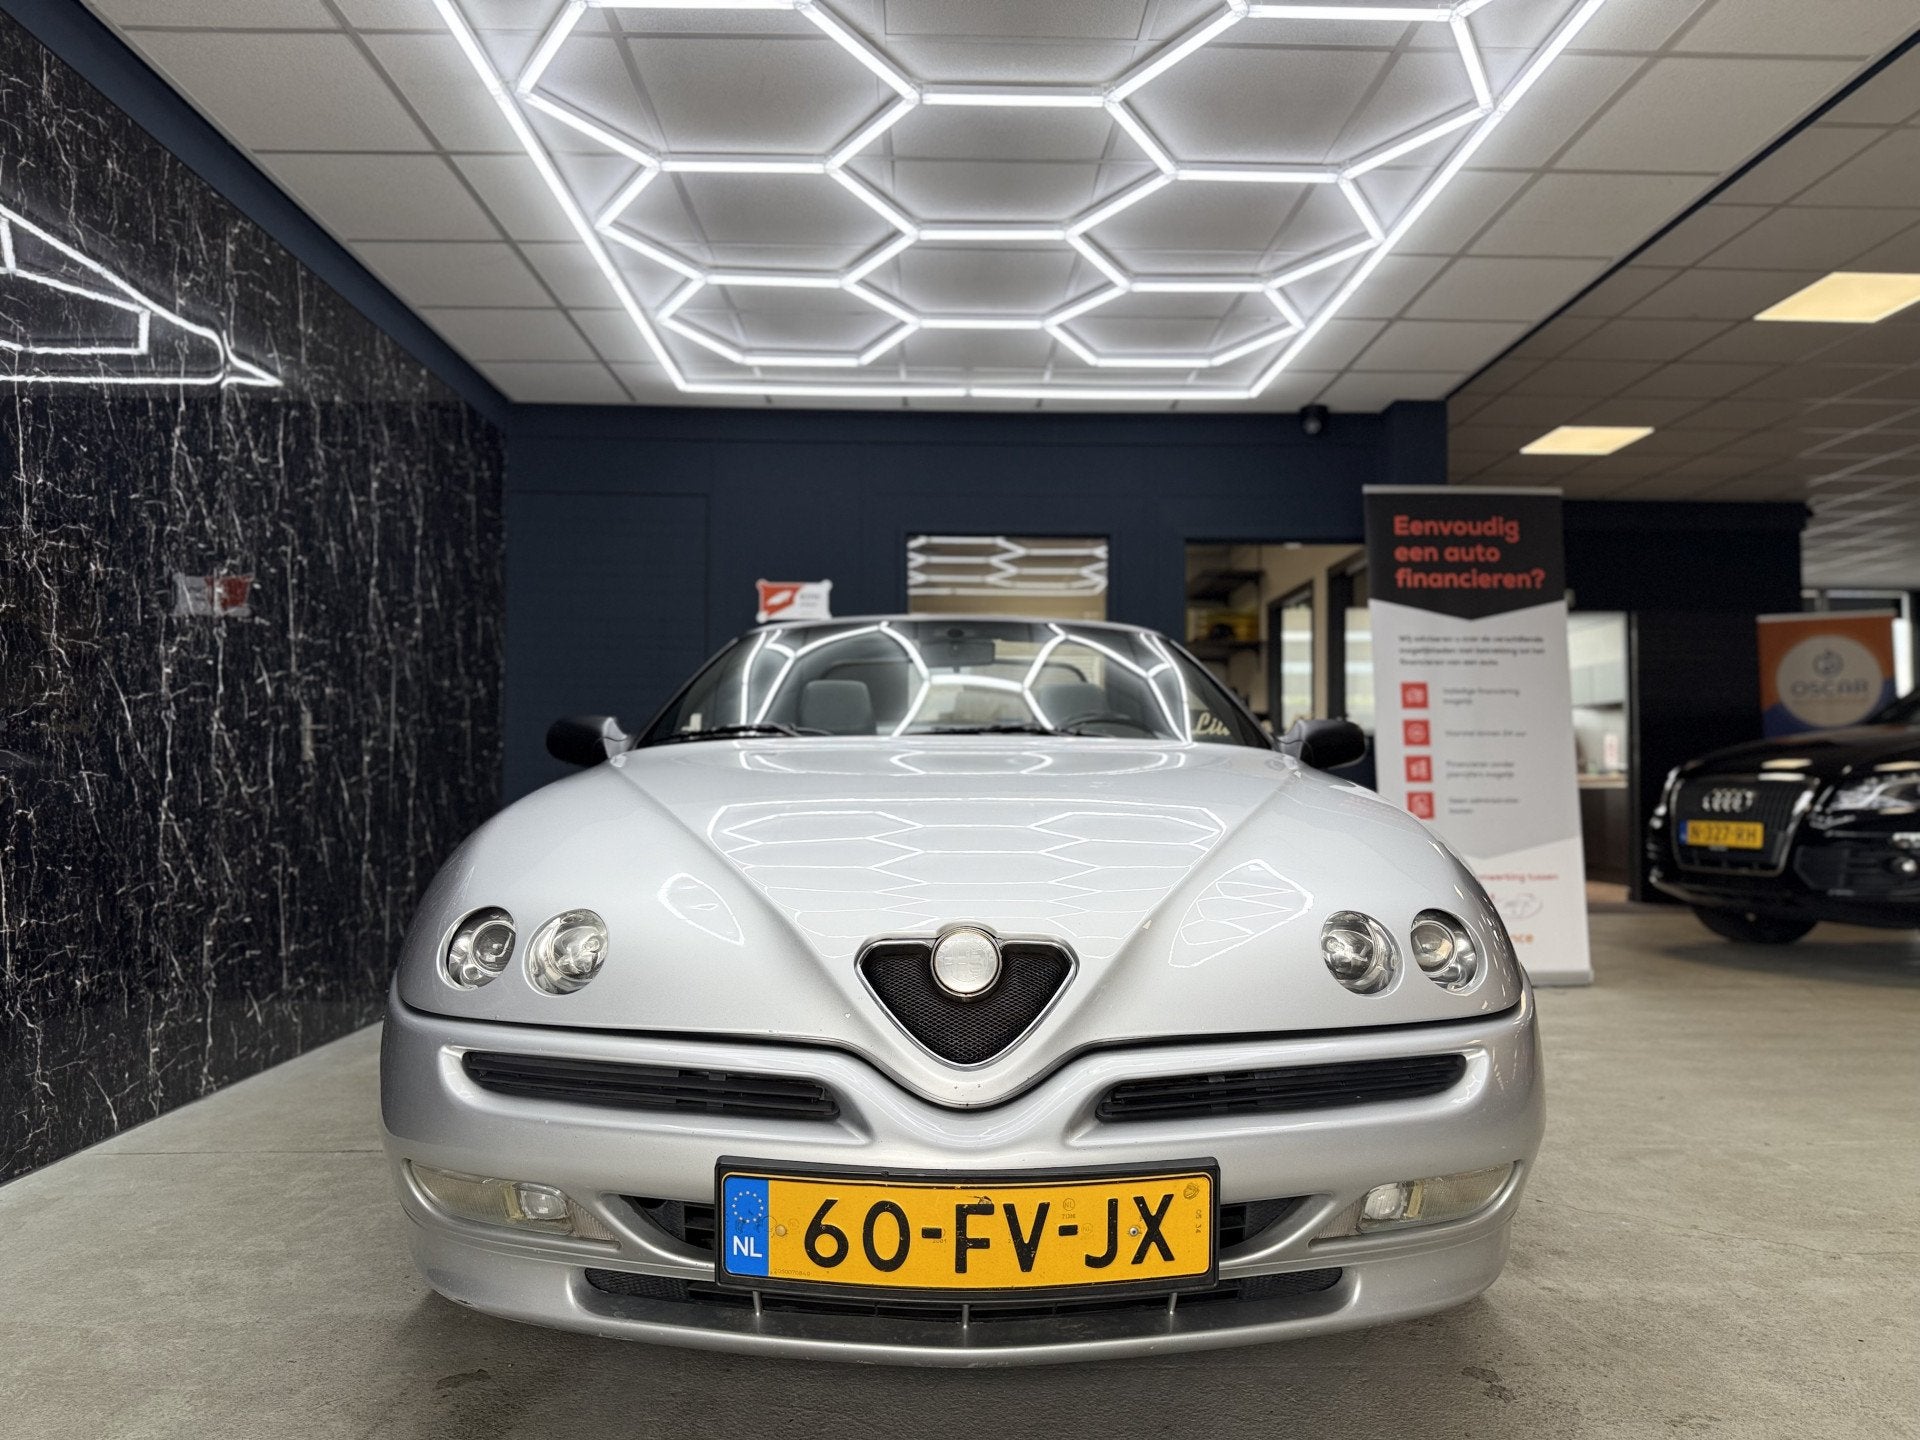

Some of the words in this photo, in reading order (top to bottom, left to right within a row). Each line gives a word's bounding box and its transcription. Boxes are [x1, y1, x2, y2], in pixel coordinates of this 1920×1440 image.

[1393, 514, 1521, 543] Eenvoudig
[1394, 544, 1439, 563] een
[1444, 543, 1501, 563] auto
[1395, 566, 1546, 590] financieren?
[804, 1192, 1176, 1275] 60-FV-JX
[733, 1235, 763, 1258] NL
